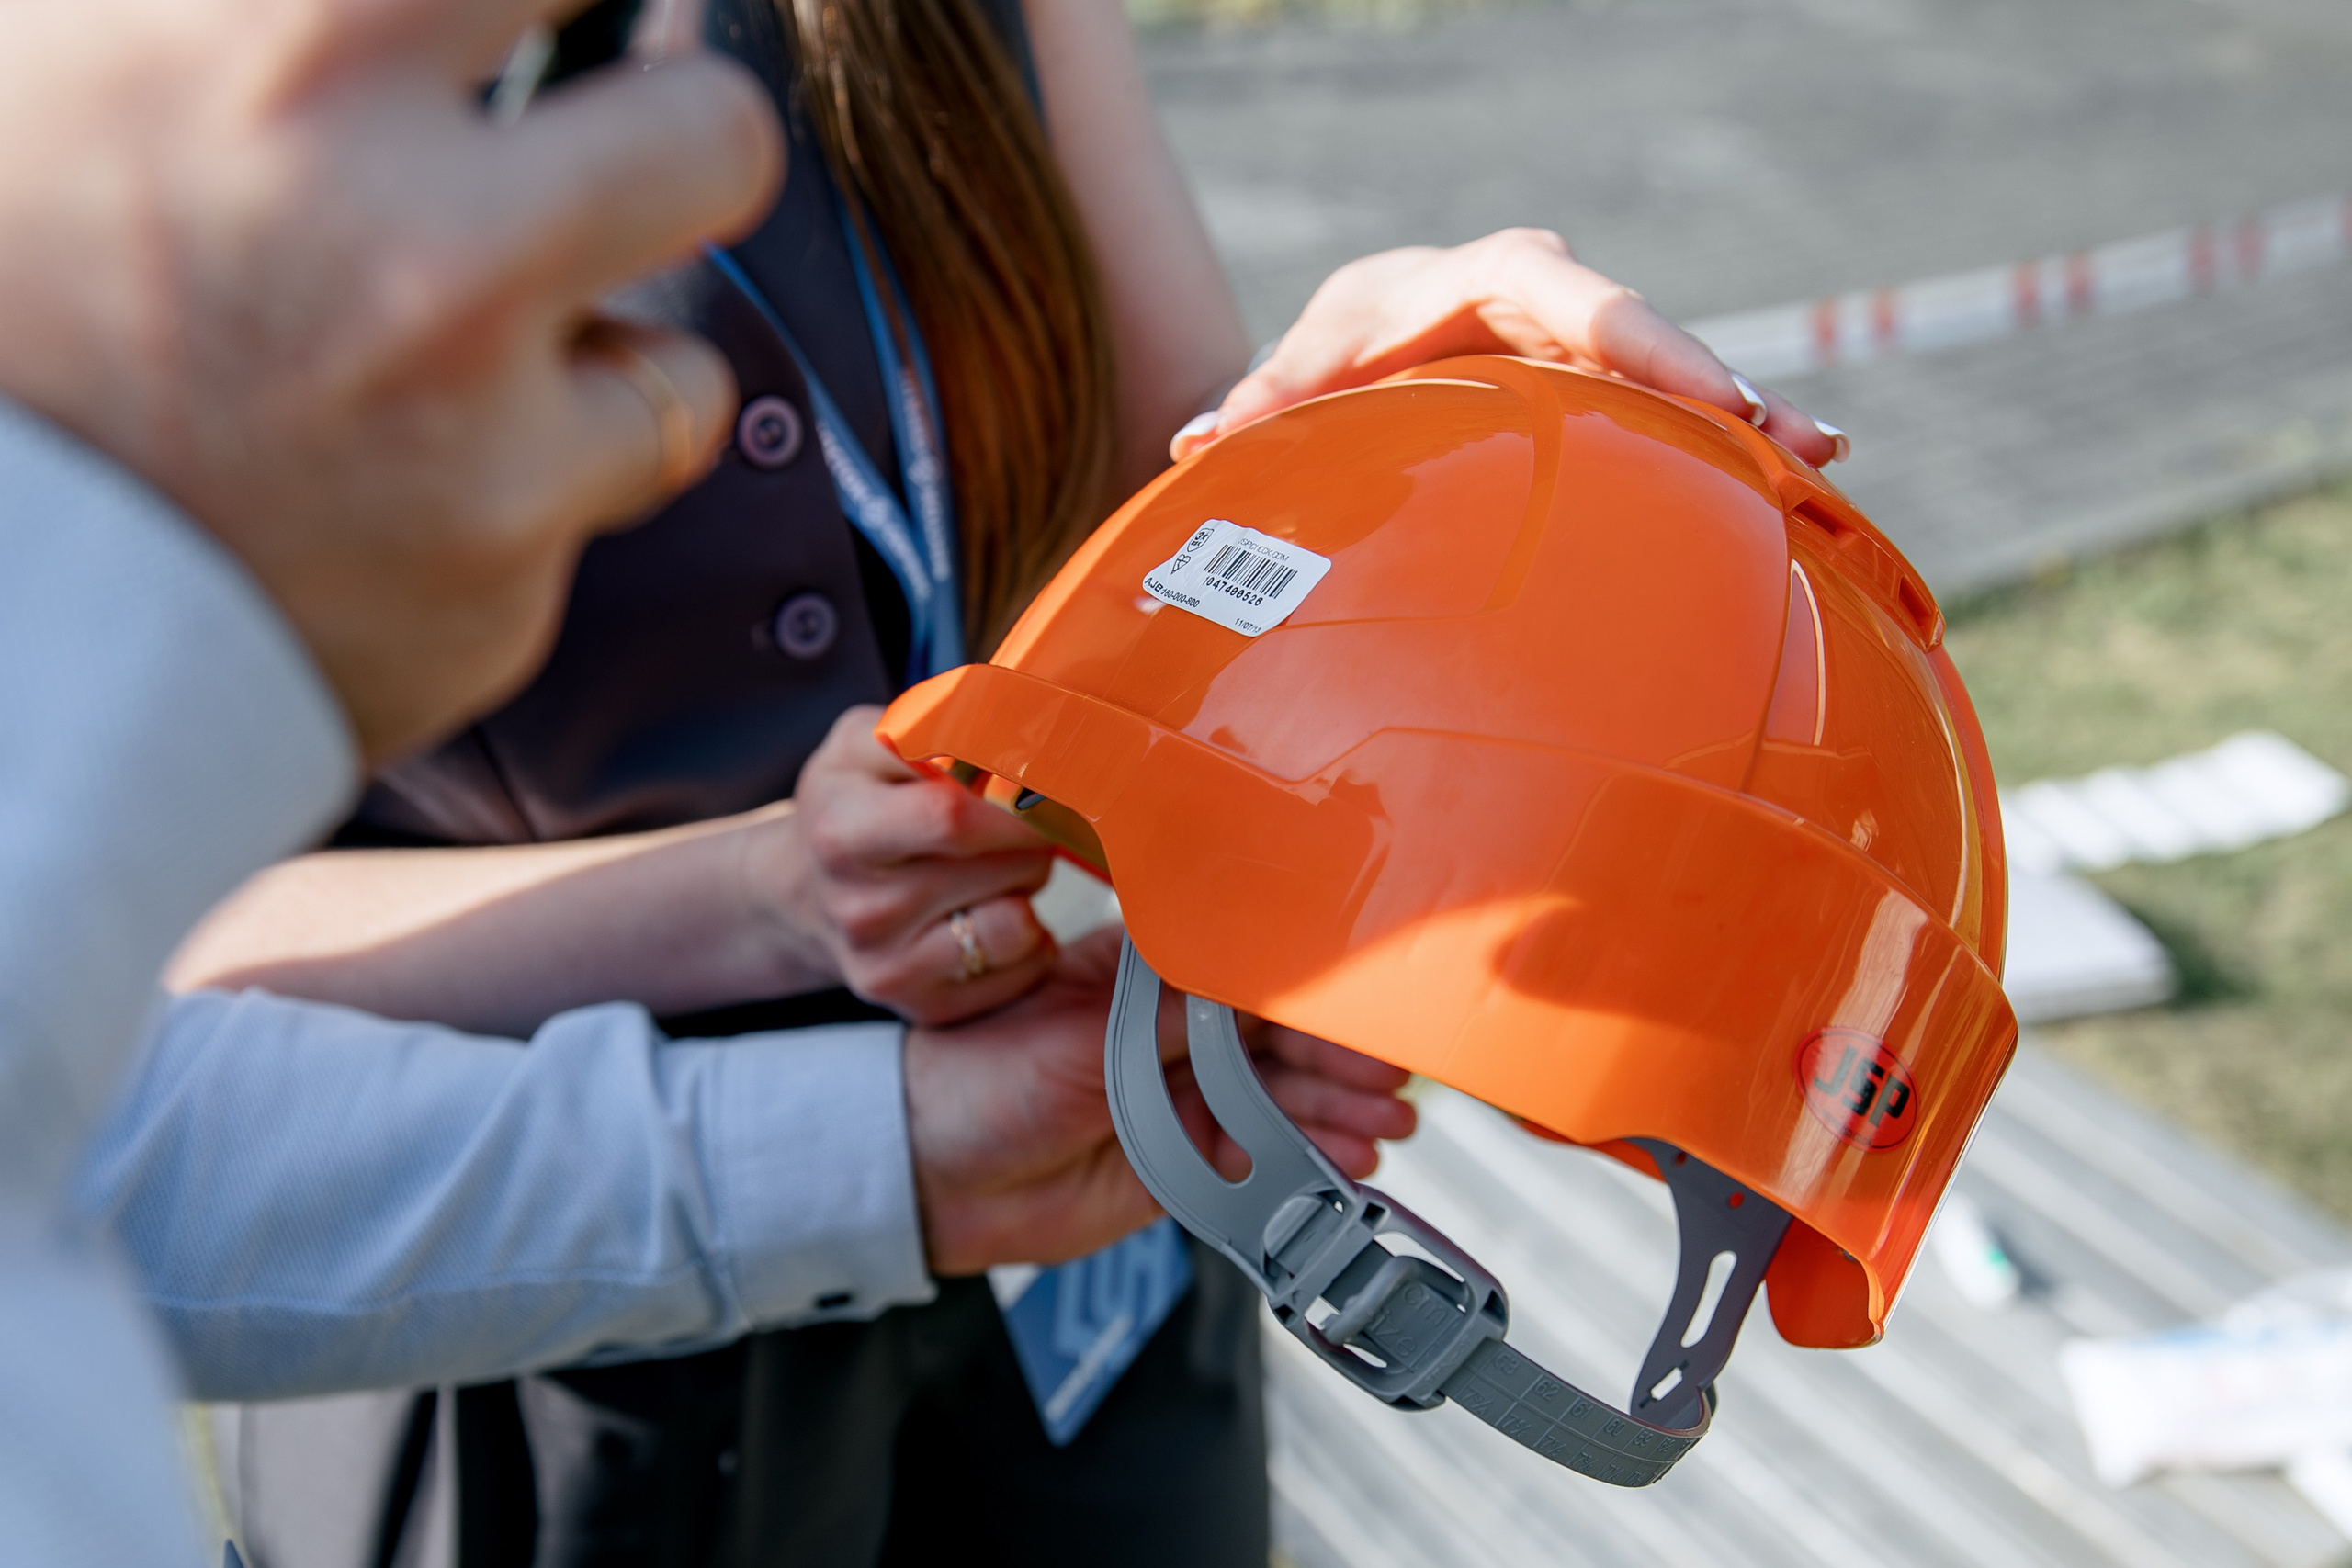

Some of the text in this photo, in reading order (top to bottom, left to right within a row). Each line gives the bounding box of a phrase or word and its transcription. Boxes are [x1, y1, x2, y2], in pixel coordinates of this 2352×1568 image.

[1814, 1044, 1910, 1128] JSP
[1369, 1309, 1416, 1359] ize
[1533, 1378, 1561, 1401] 62
[1570, 1401, 1593, 1420] 61
[1603, 1418, 1625, 1438] 60
